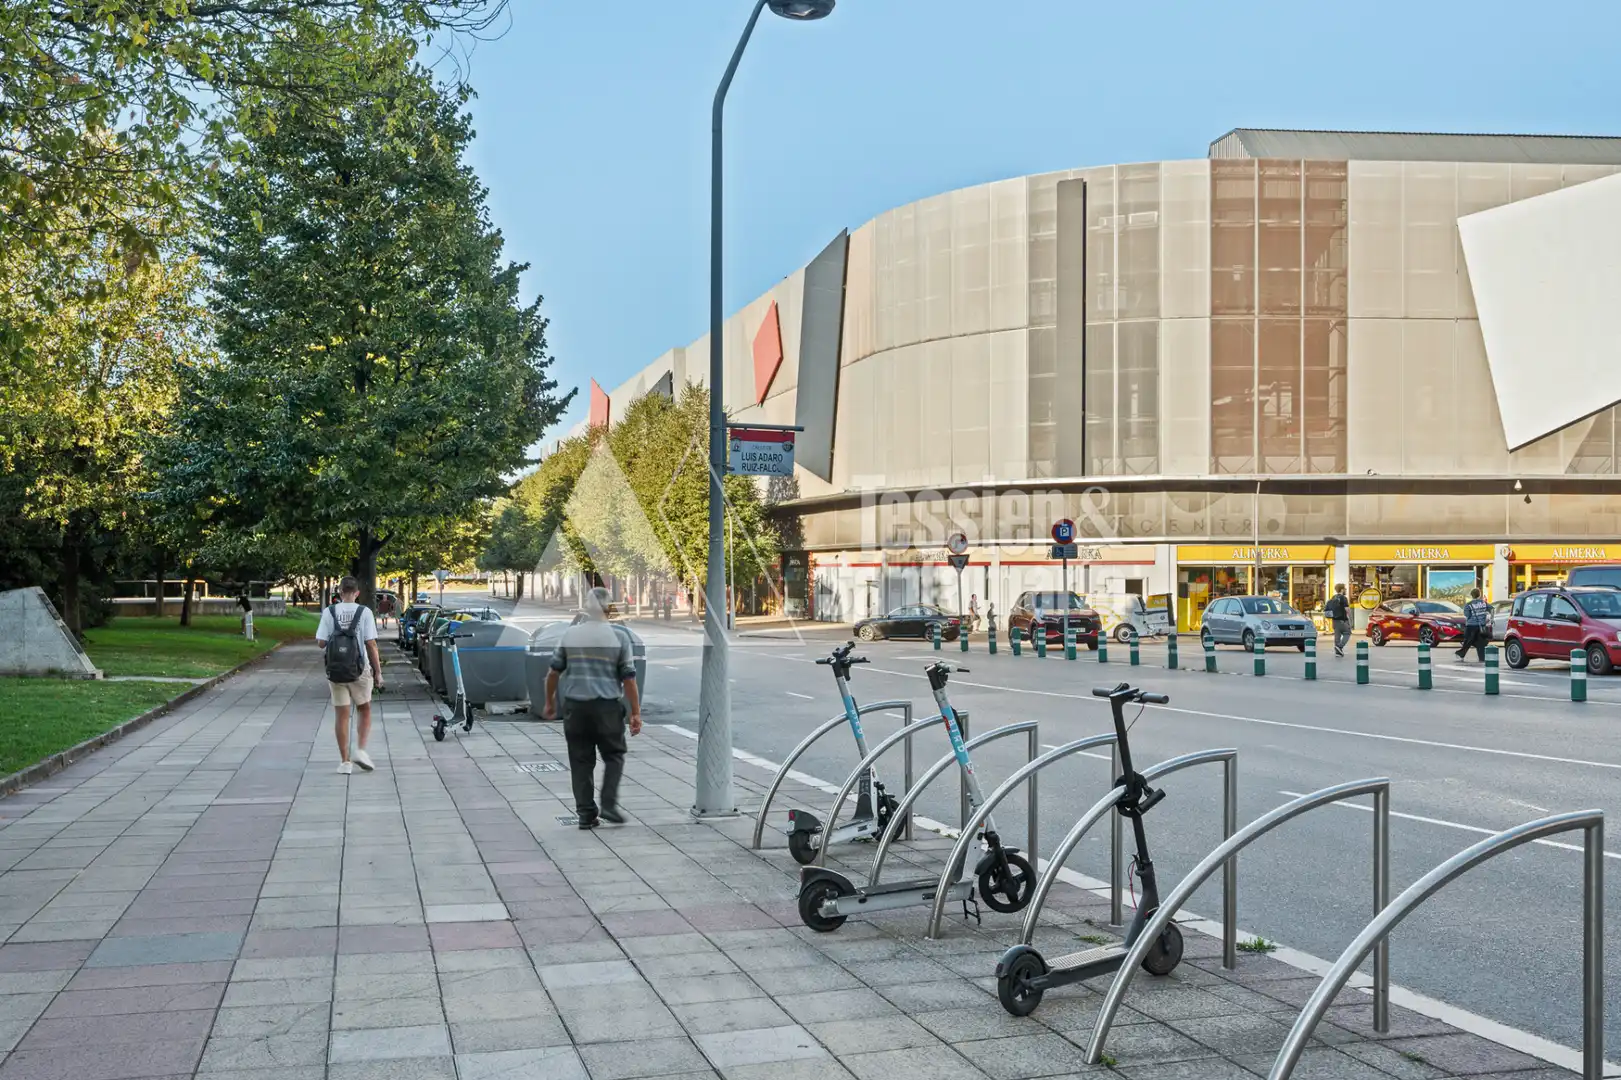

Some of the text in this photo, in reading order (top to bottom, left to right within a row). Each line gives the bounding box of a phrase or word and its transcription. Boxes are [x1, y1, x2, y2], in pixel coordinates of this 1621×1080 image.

[741, 452, 783, 463] LUIS ADARO
[1394, 548, 1450, 559] ALIMERKA
[1552, 548, 1606, 558] ALIMERKA
